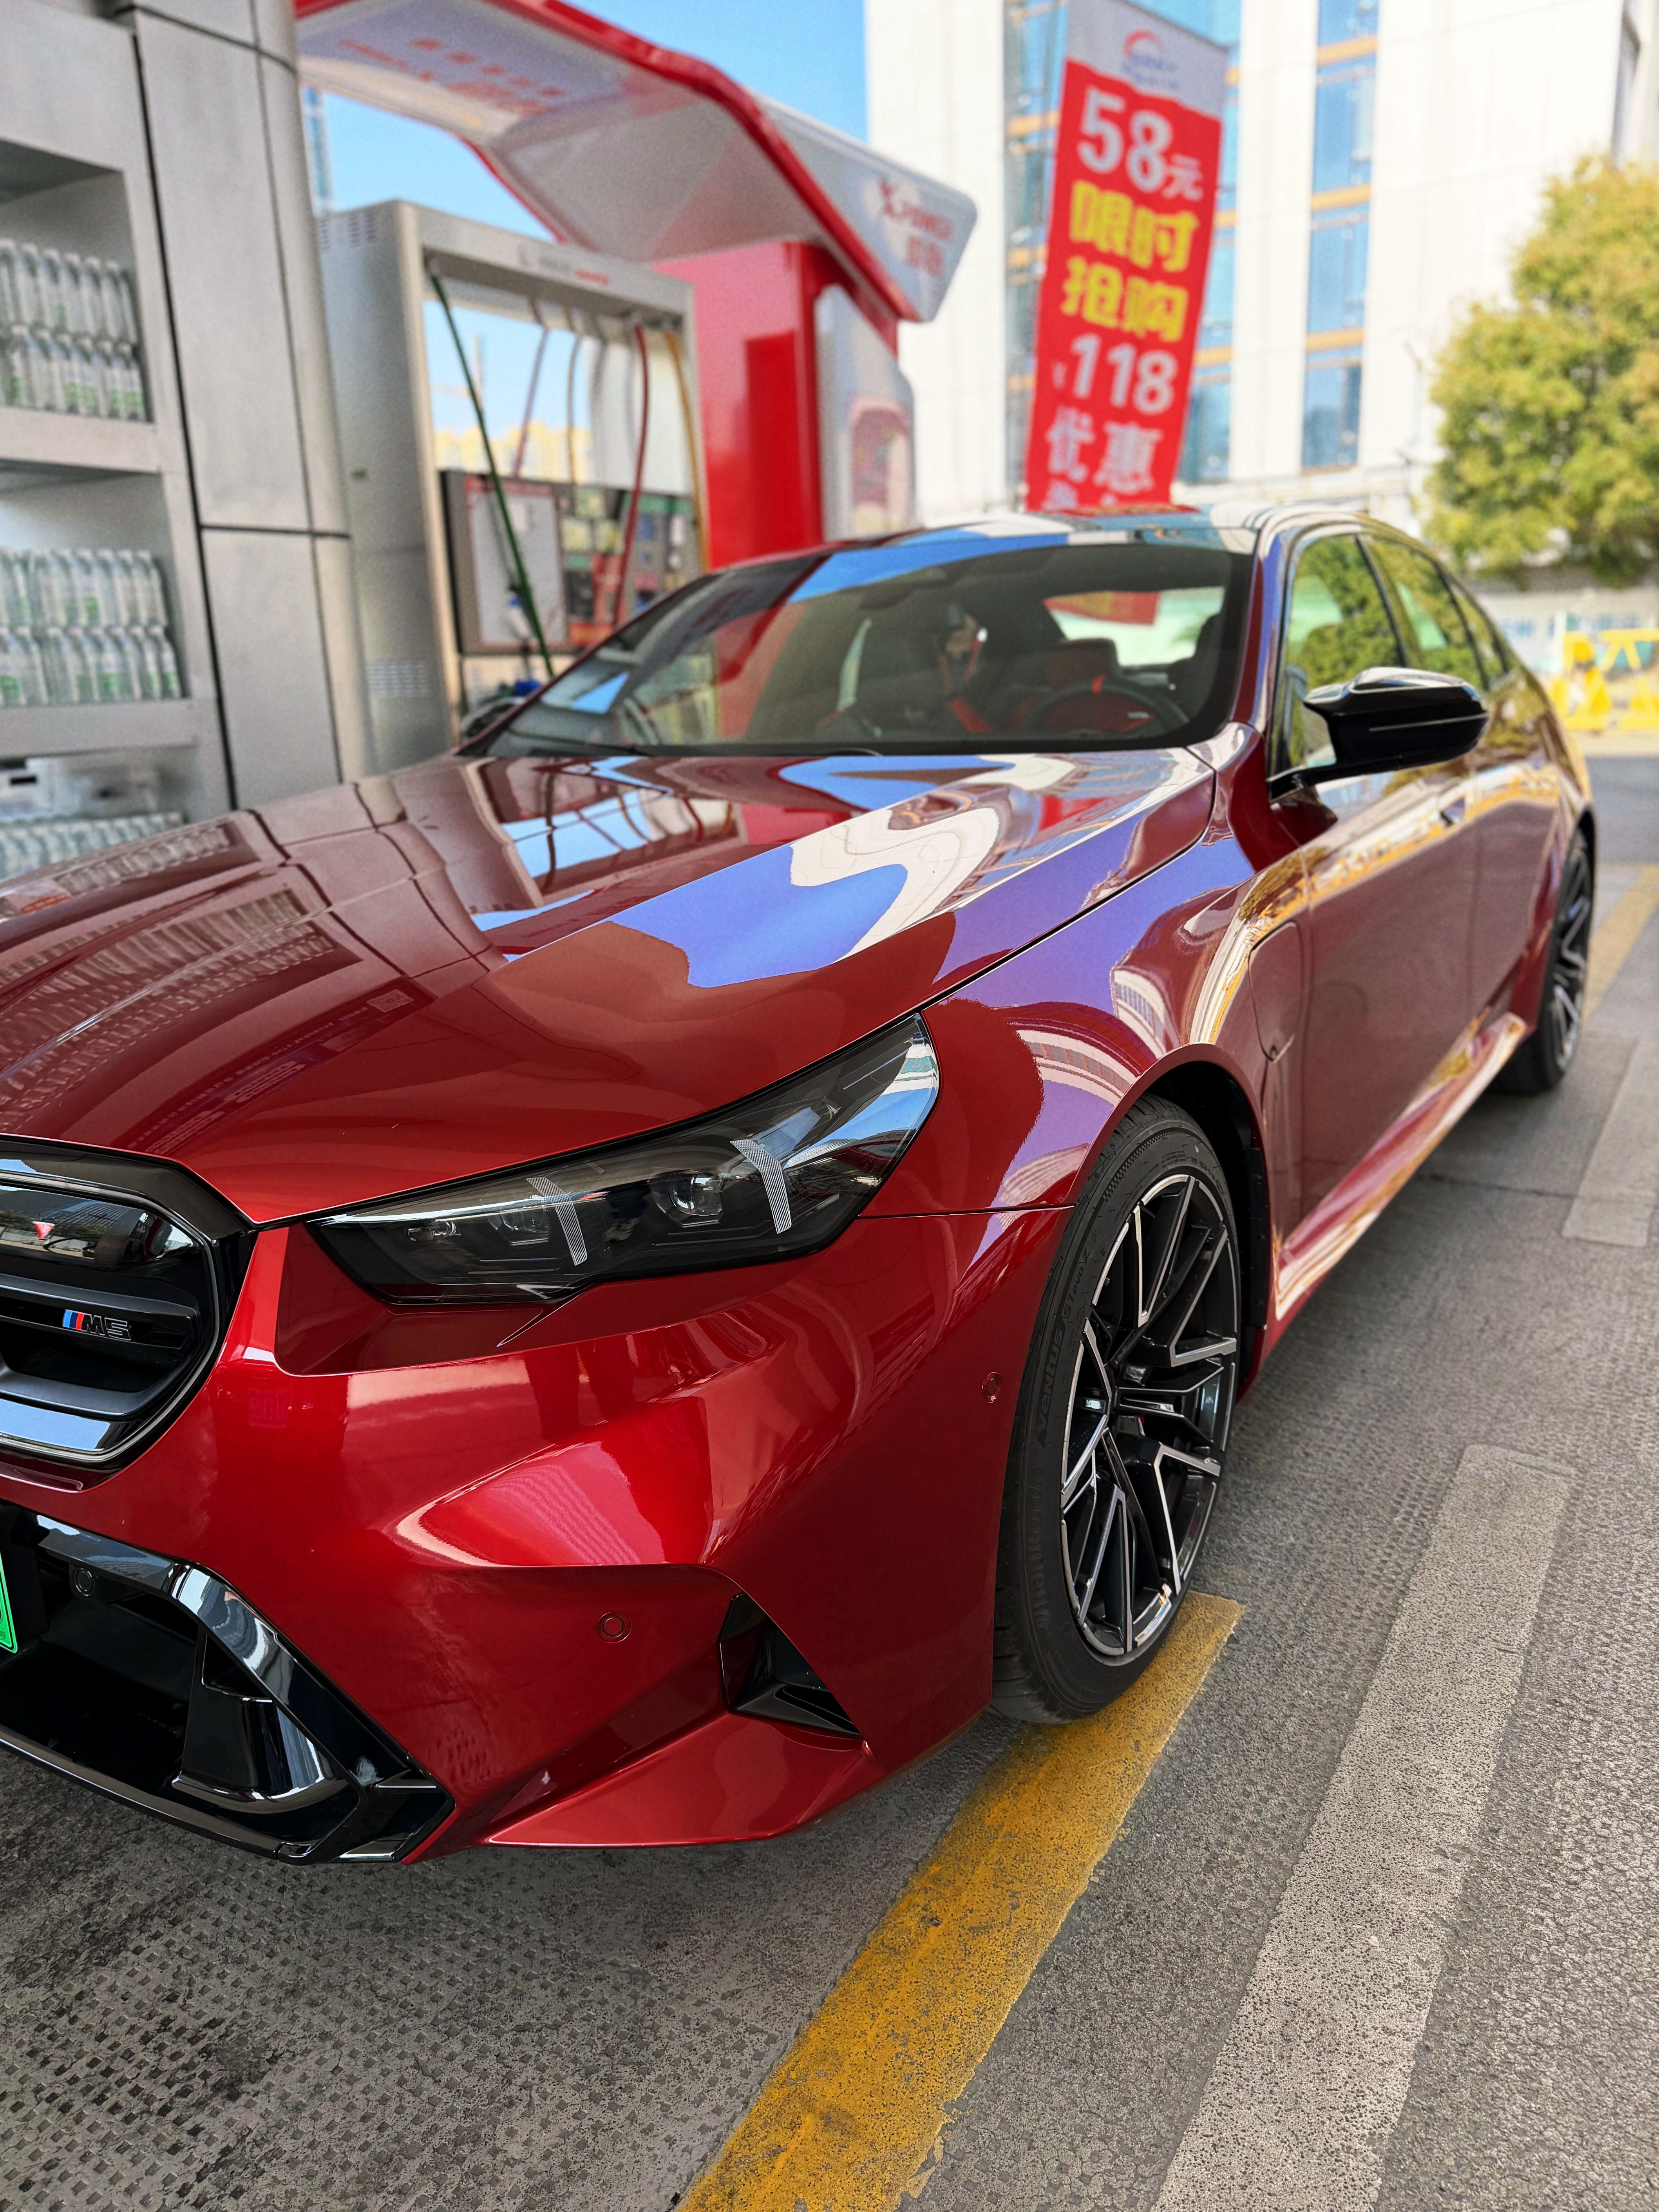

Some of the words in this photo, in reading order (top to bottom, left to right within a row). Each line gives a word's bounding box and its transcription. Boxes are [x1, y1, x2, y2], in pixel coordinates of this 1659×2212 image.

[1077, 87, 1203, 201] 58元
[1070, 181, 1199, 271] 限时
[1061, 256, 1189, 342] 抢购
[81, 1313, 132, 1341] M5
